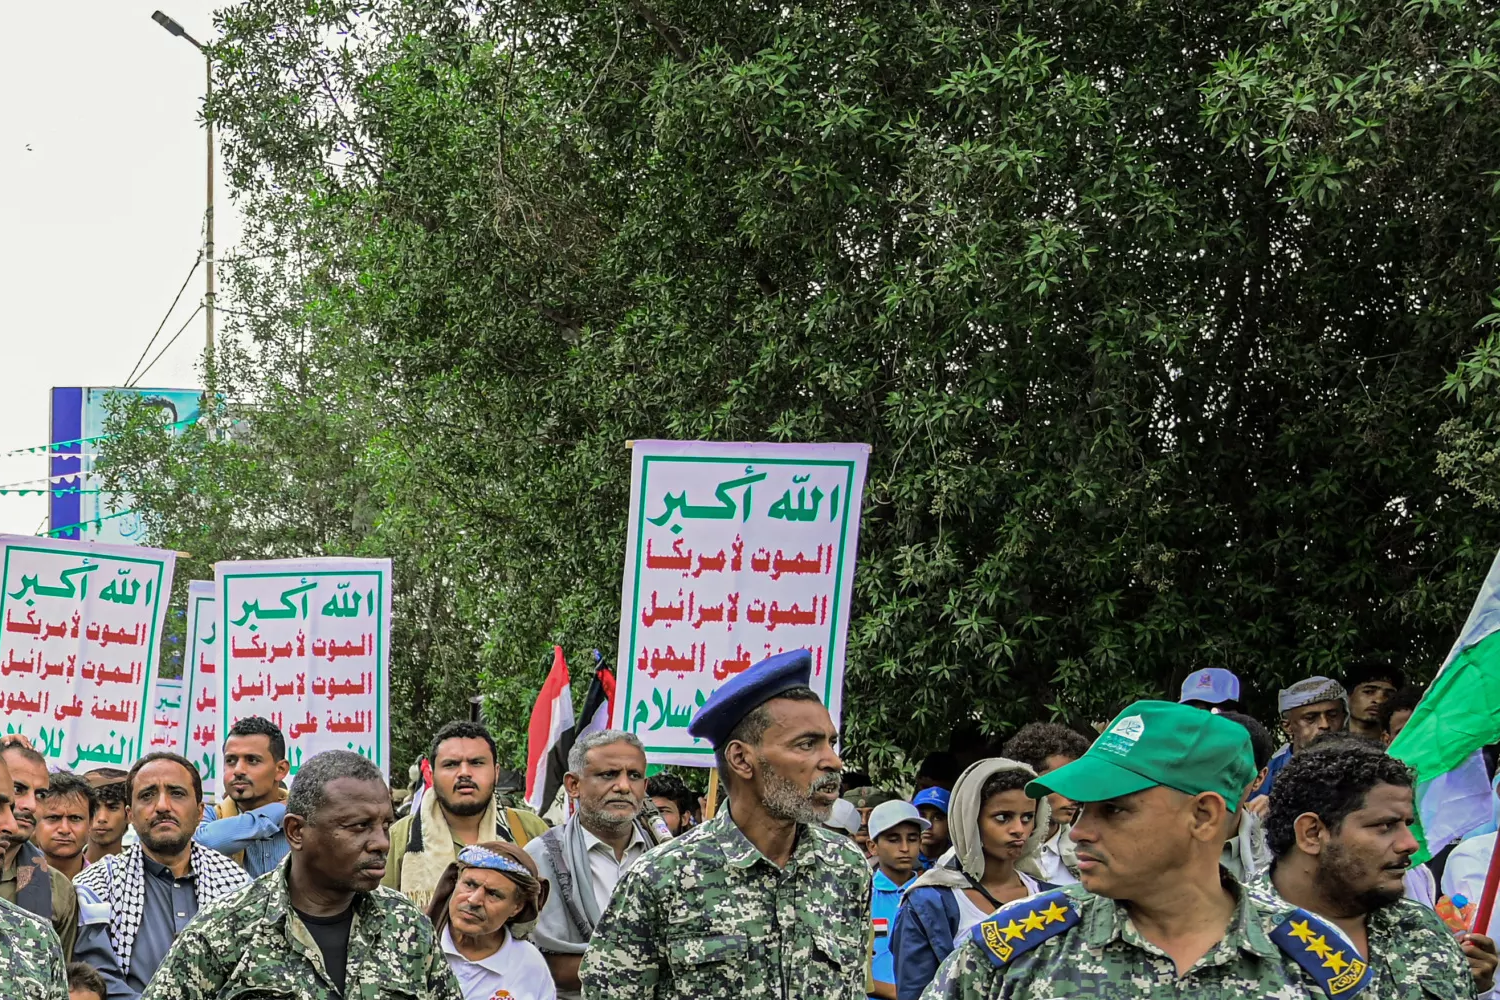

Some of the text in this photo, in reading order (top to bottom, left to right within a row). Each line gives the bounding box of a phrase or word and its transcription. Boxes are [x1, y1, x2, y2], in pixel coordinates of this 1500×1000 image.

[646, 465, 840, 535] الله أكبر
[646, 534, 833, 581] الموت لأمريكا
[7, 558, 153, 607] الله أكبر
[321, 581, 374, 618] الله
[230, 577, 318, 632] أكبر
[641, 588, 828, 632] الموت لإسرائيل
[6, 608, 147, 648] الموت لأمريكا
[231, 628, 306, 664] لأمريكا
[311, 632, 373, 662] الموت
[1, 648, 142, 687] الموت لإسرائيل
[637, 641, 706, 680] اليهود
[231, 671, 306, 703] لإسرائيل
[311, 671, 373, 701] الموت
[54, 694, 84, 721] على
[89, 694, 138, 724] اللعنة
[289, 710, 318, 740] على
[326, 709, 372, 733] اللعنة
[67, 729, 134, 769] النصر
